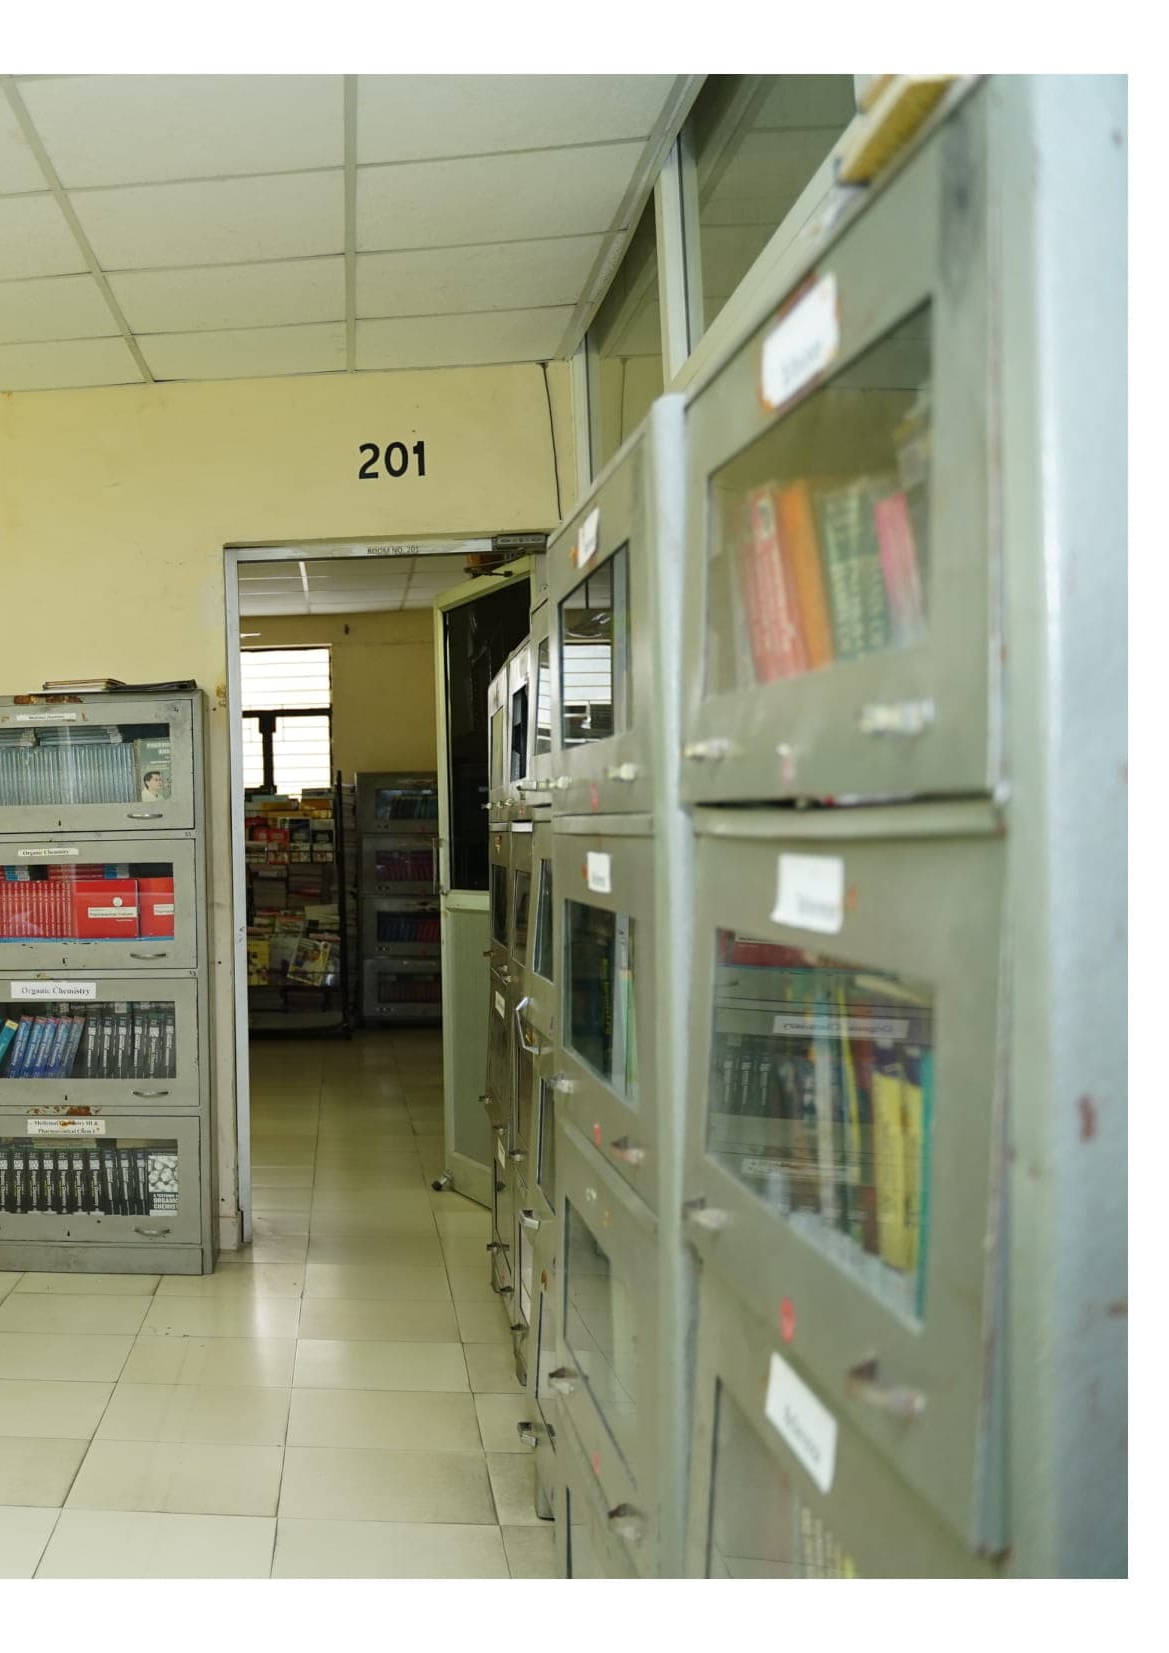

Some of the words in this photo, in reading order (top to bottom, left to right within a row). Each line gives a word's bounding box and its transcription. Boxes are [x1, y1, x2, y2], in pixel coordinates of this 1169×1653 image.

[359, 441, 426, 480] 201
[22, 987, 51, 995] Organic
[52, 986, 89, 996] Chemistry
